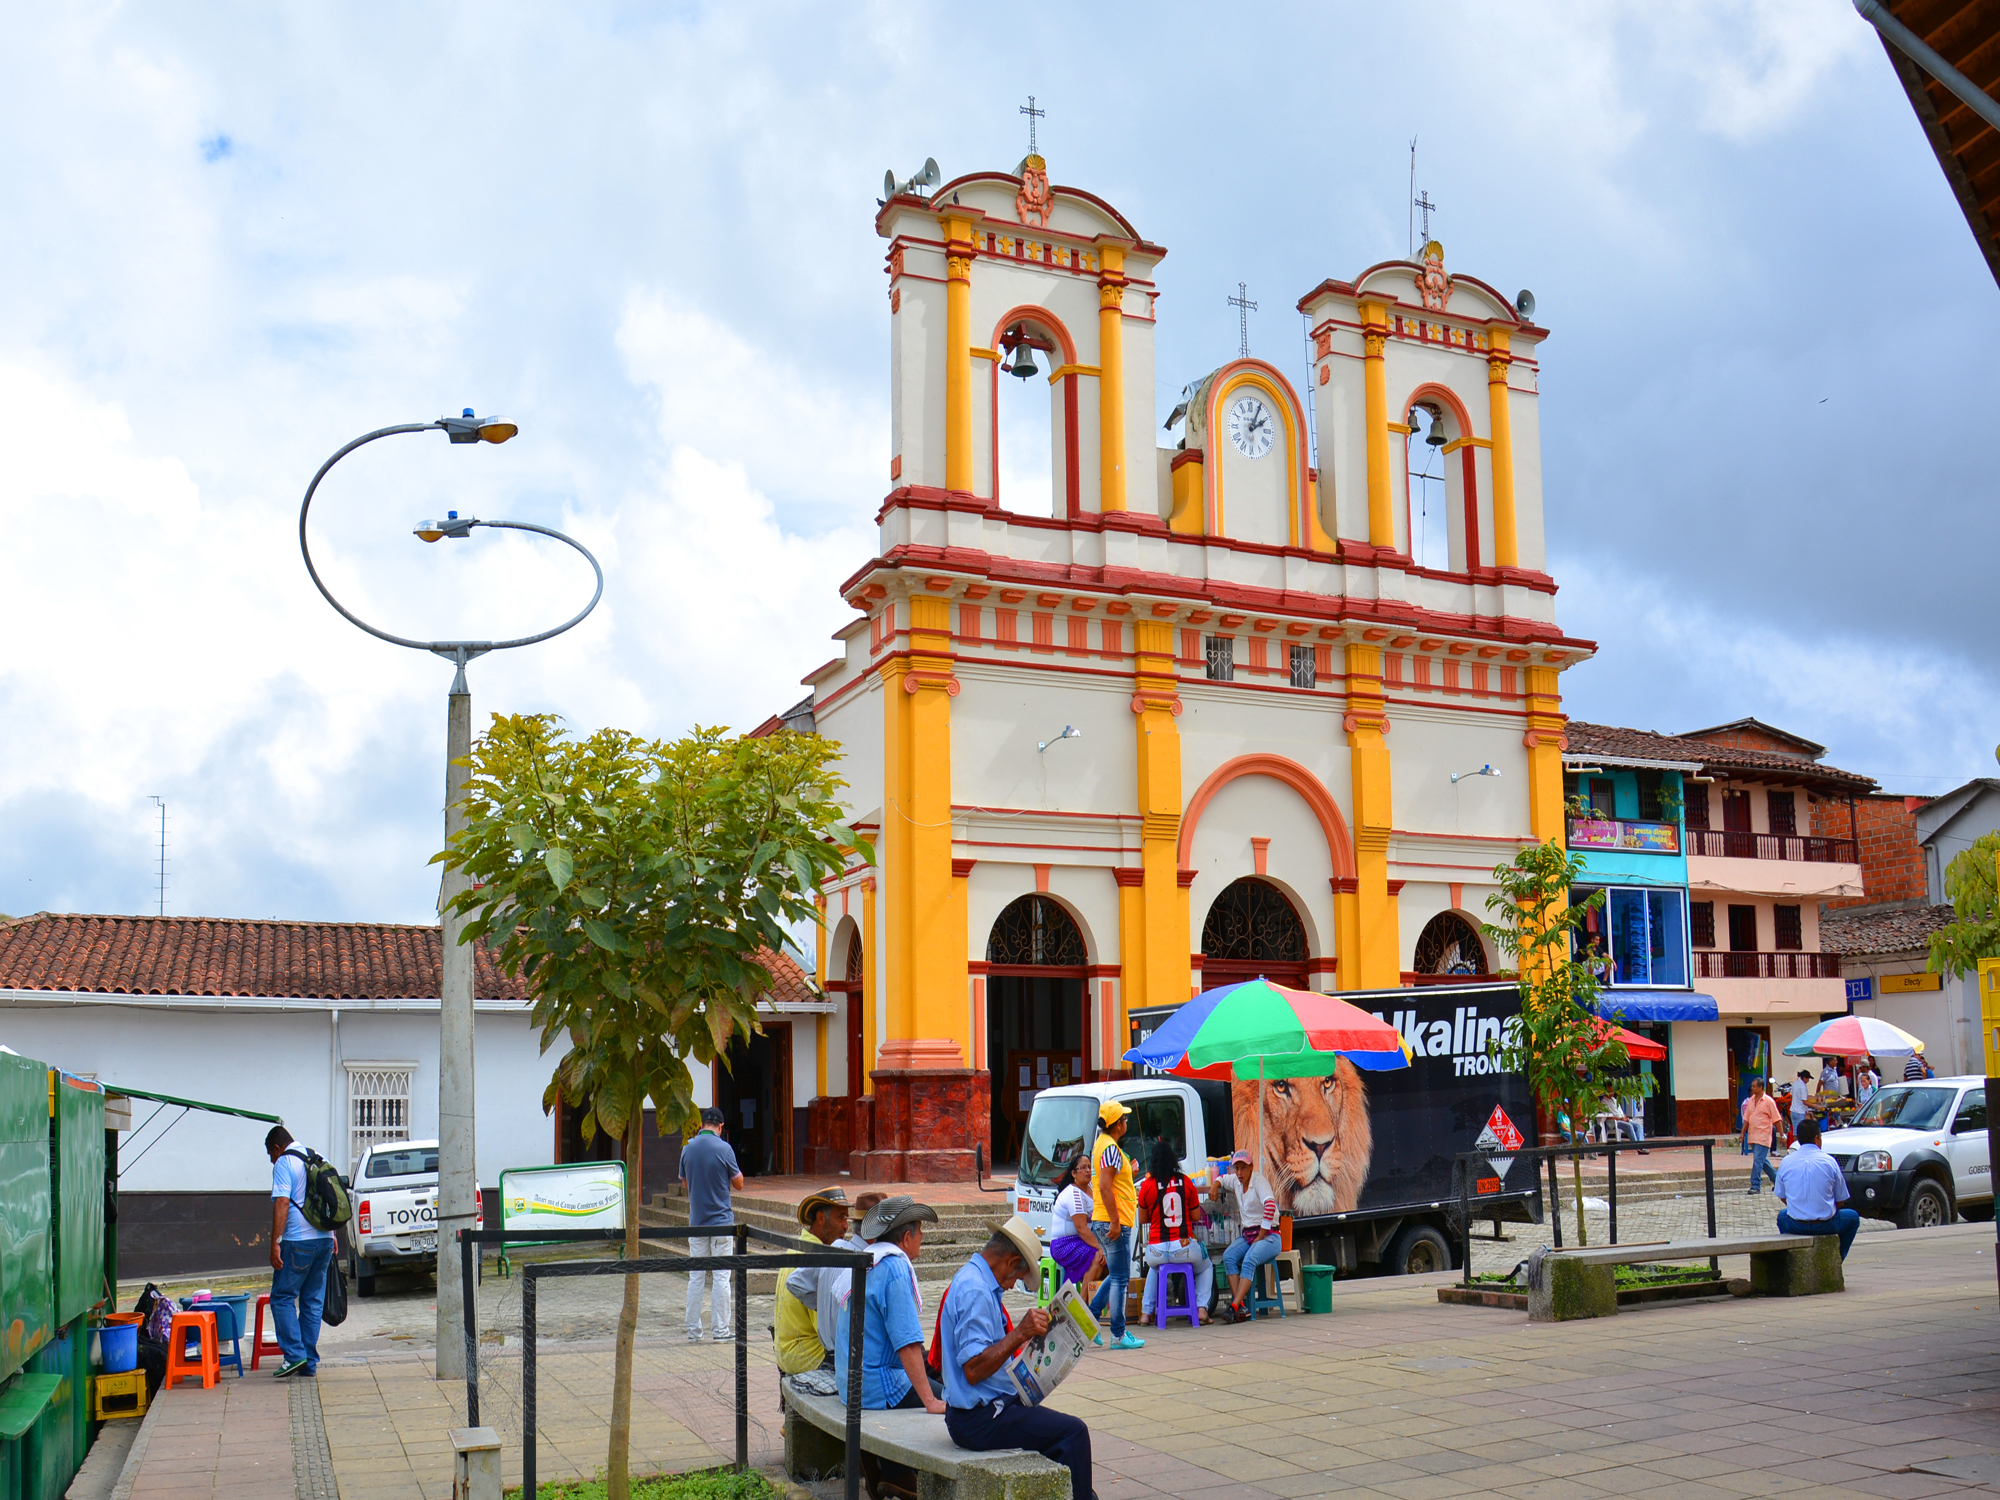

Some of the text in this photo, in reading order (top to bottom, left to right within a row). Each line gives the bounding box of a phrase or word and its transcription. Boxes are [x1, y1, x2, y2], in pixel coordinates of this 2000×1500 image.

[1653, 828, 1672, 836] dinero
[1029, 1200, 1052, 1213] TRONEX
[1163, 1192, 1182, 1227] 9
[387, 1207, 438, 1224] TOYOT
[1072, 1342, 1084, 1358] 15
